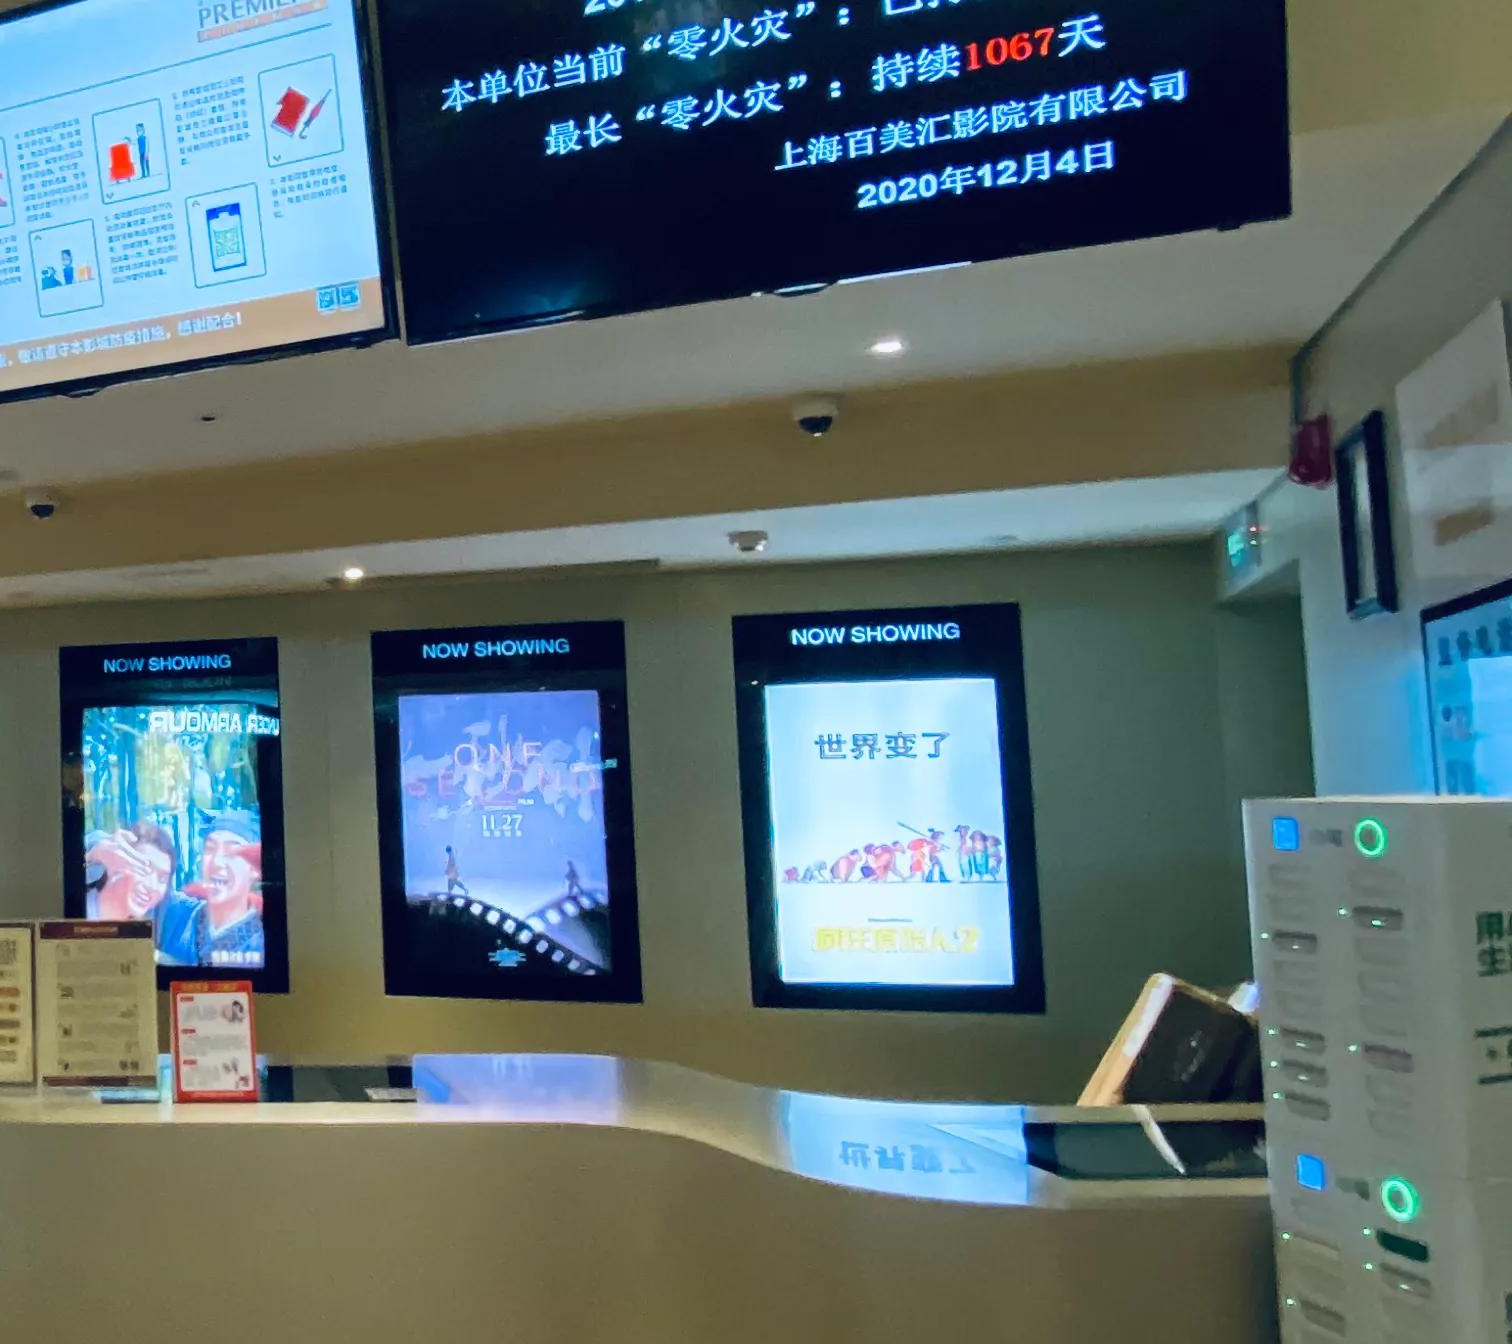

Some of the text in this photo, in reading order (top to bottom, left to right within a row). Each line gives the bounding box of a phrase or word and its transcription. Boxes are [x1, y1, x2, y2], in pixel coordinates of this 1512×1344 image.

[773, 69, 1189, 172] 上海百美汇影院有限公司
[856, 139, 1116, 211] 2020年12月4日
[791, 622, 961, 646] NOW SHOWING
[422, 638, 571, 659] NOW SHOWING
[103, 654, 232, 673] NOW SHOWING
[813, 730, 951, 761] 世界变了
